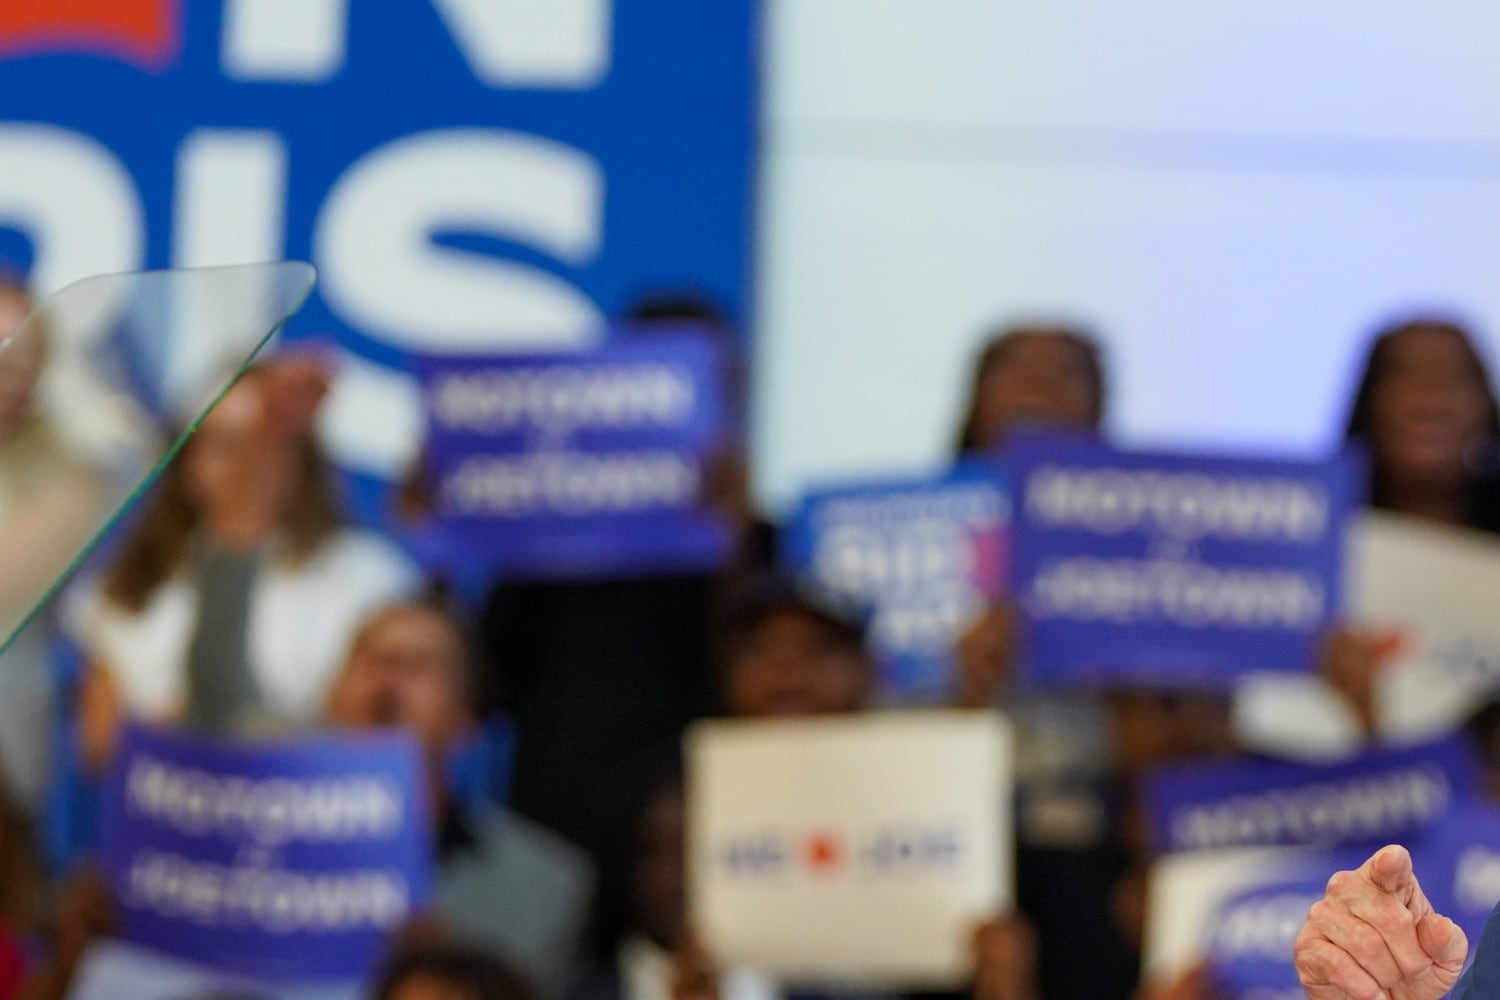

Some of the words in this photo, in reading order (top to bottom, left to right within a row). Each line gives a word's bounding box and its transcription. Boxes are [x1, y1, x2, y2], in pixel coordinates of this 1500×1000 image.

[436, 368, 694, 432] MOTOWN
[448, 455, 696, 516] JOETOWN
[1024, 462, 1330, 540] MOTOWN
[1036, 558, 1322, 626] JOETOWN
[126, 757, 396, 836] MOTOWN
[128, 850, 408, 930] JOETOWN
